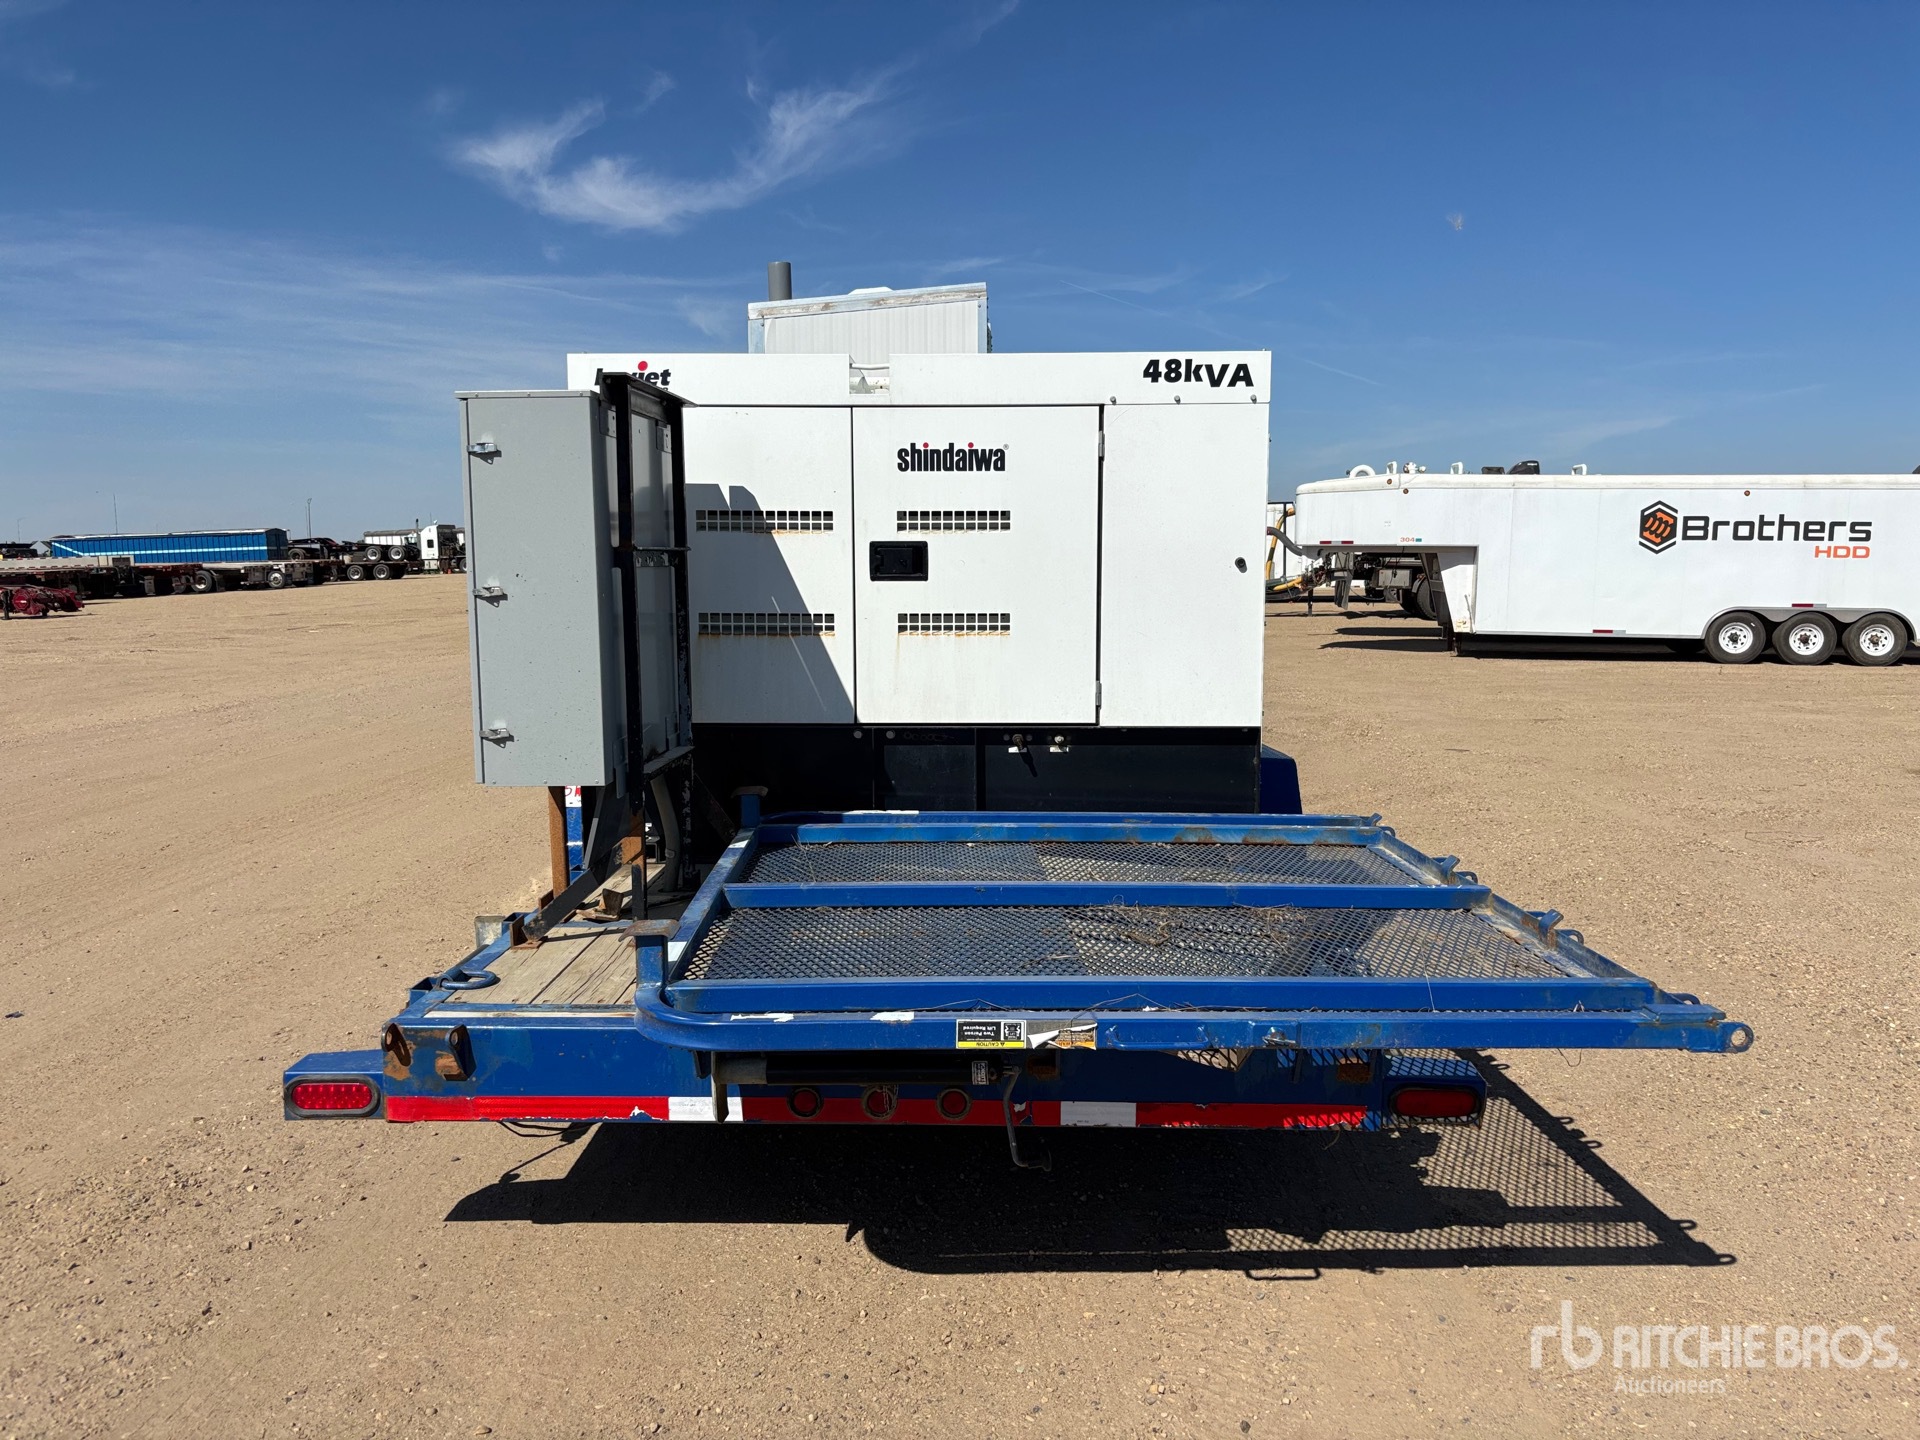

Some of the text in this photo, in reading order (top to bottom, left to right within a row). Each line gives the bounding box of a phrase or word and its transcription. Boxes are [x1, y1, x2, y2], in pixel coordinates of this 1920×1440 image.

[1143, 358, 1255, 388] 48kVA
[897, 442, 1006, 472] shindaiwa
[1681, 513, 1873, 542] Brothers
[1814, 545, 1870, 559] HDD
